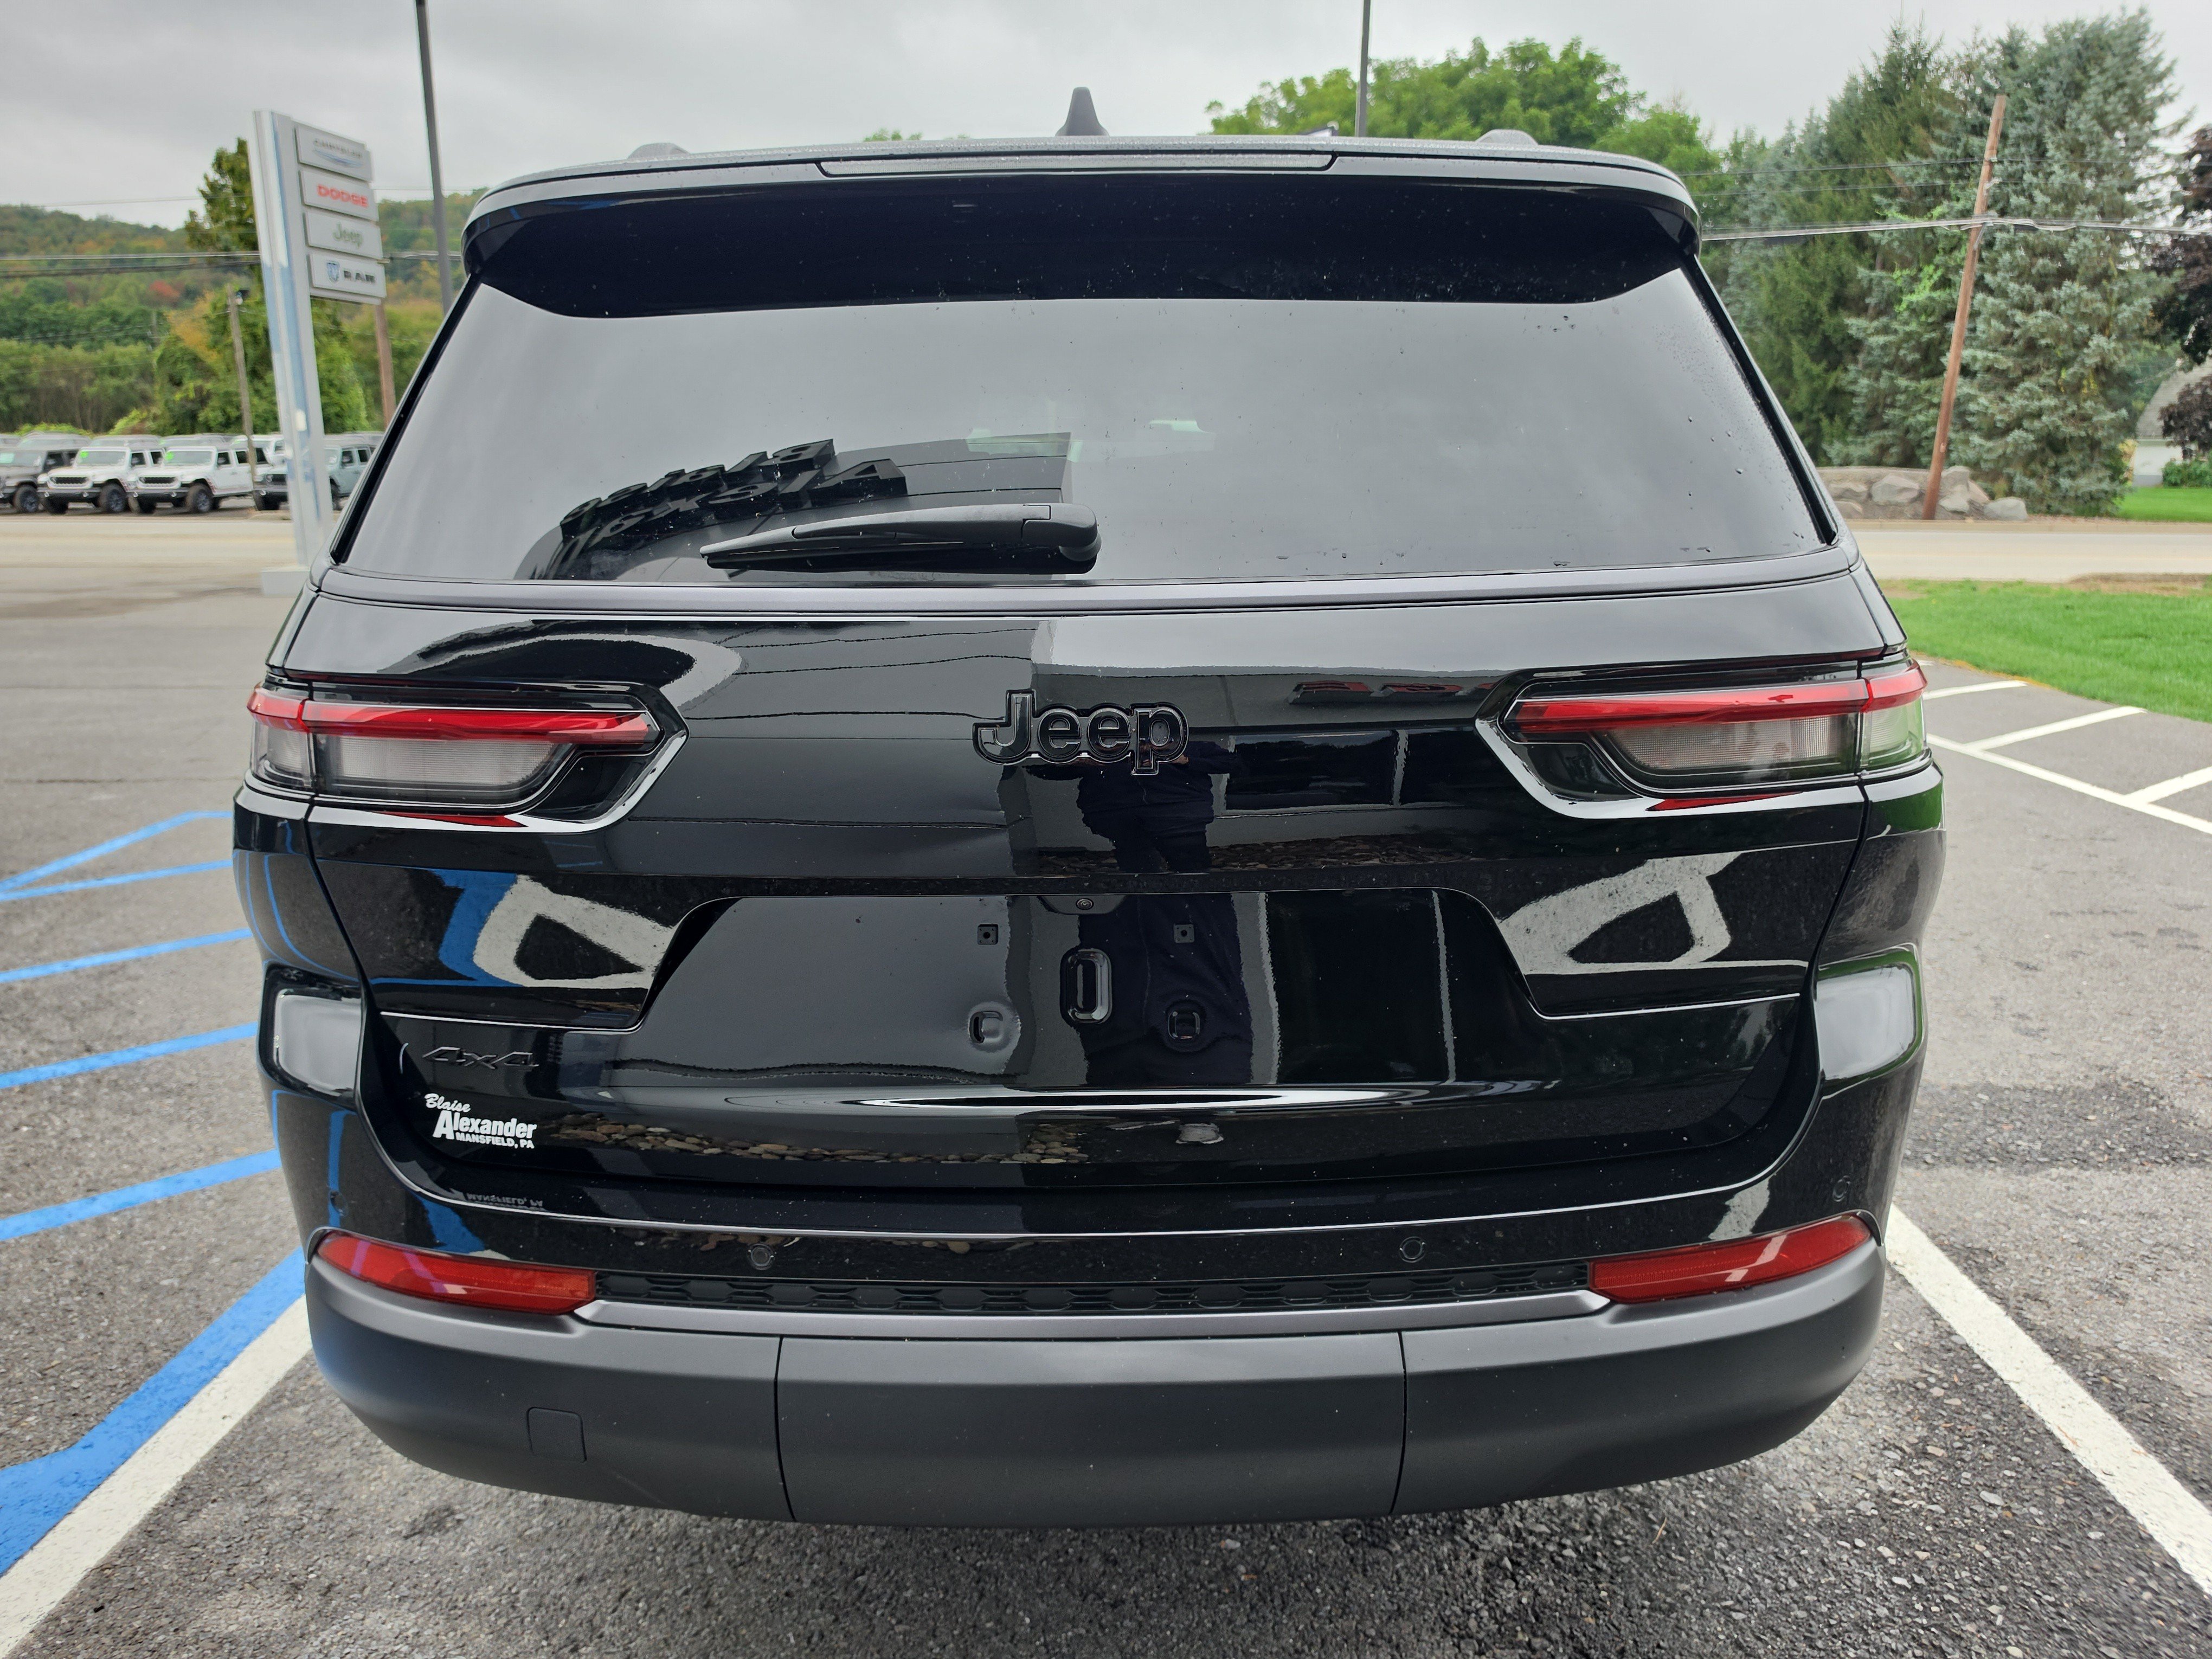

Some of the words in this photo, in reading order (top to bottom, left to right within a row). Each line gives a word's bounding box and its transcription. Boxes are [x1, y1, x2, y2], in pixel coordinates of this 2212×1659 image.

[317, 184, 368, 208] DODGE
[333, 221, 363, 248] Jeep
[343, 270, 376, 282] RAM
[973, 689, 1189, 776] Jeep
[425, 1093, 471, 1113] Blaise
[433, 1110, 537, 1140] Alexander
[455, 1132, 518, 1149] MANSFIELD,
[519, 1139, 535, 1149] PA
